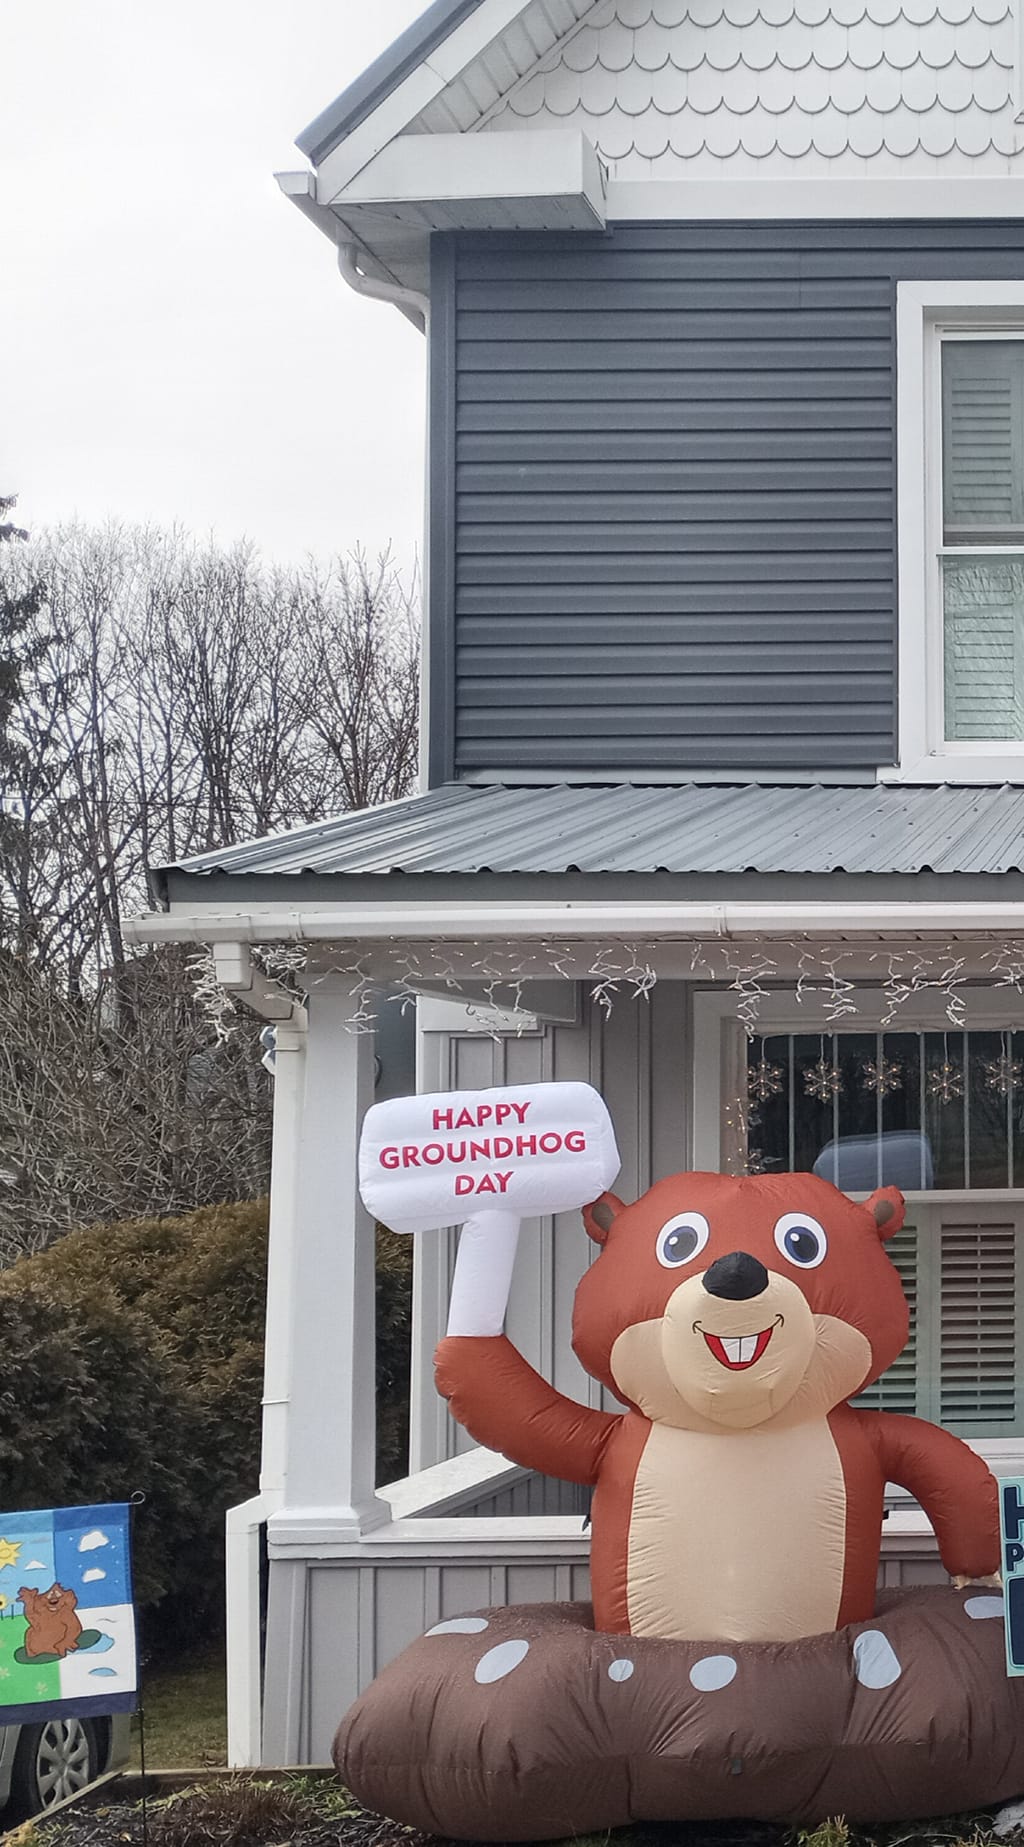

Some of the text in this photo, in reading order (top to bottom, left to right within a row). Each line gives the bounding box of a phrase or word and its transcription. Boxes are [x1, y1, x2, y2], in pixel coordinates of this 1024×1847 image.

[432, 1101, 531, 1130] HAPPY
[379, 1130, 586, 1169] GROUNDHOG
[455, 1171, 514, 1195] DAY
